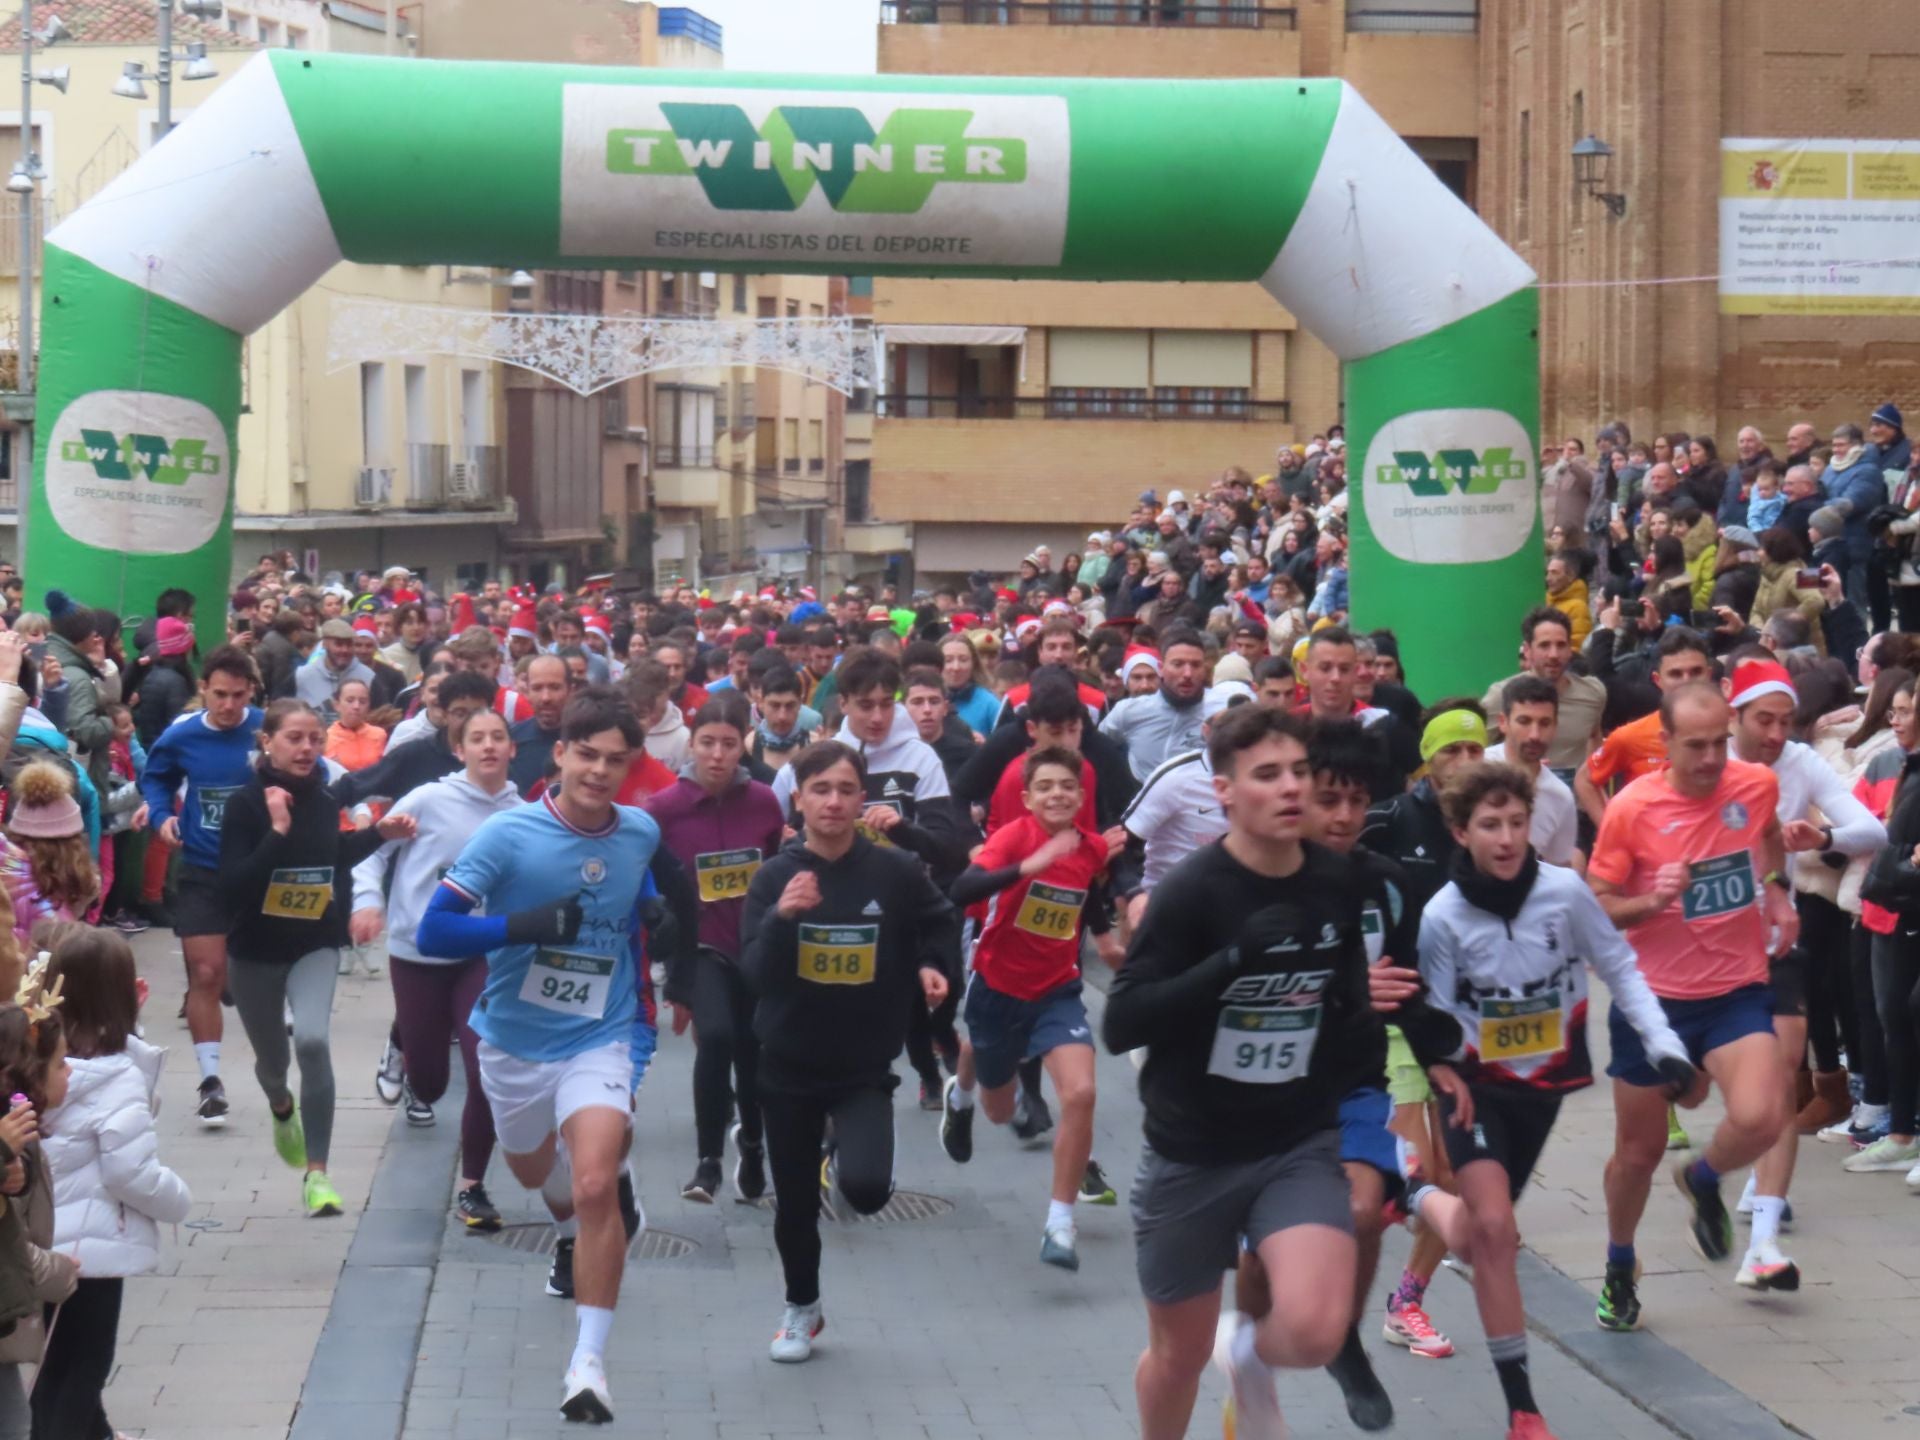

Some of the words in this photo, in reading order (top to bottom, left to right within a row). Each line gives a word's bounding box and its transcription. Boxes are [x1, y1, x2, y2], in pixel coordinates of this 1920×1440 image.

[624, 135, 1007, 175] TWINNER
[655, 230, 820, 251] ESPECIALISTAS
[826, 234, 865, 252] DEL
[874, 234, 972, 255] DEPORTE
[65, 444, 215, 471] TWINNER
[1381, 464, 1523, 481] TWINNER
[74, 487, 144, 502] ESPECIALISTAS
[145, 493, 164, 505] DEL
[165, 495, 204, 508] DEPORTE
[1393, 505, 1460, 518] ESPECIALISTAS
[1461, 504, 1478, 515] DEL
[1480, 503, 1516, 514] DEPORTE
[711, 870, 748, 891] 821
[280, 890, 321, 910] 827
[1691, 874, 1745, 912] 210
[1032, 906, 1071, 930] 816
[813, 952, 861, 975] 818
[540, 976, 591, 1004] 924
[1496, 1020, 1544, 1048] 801
[1235, 1042, 1297, 1070] 915
